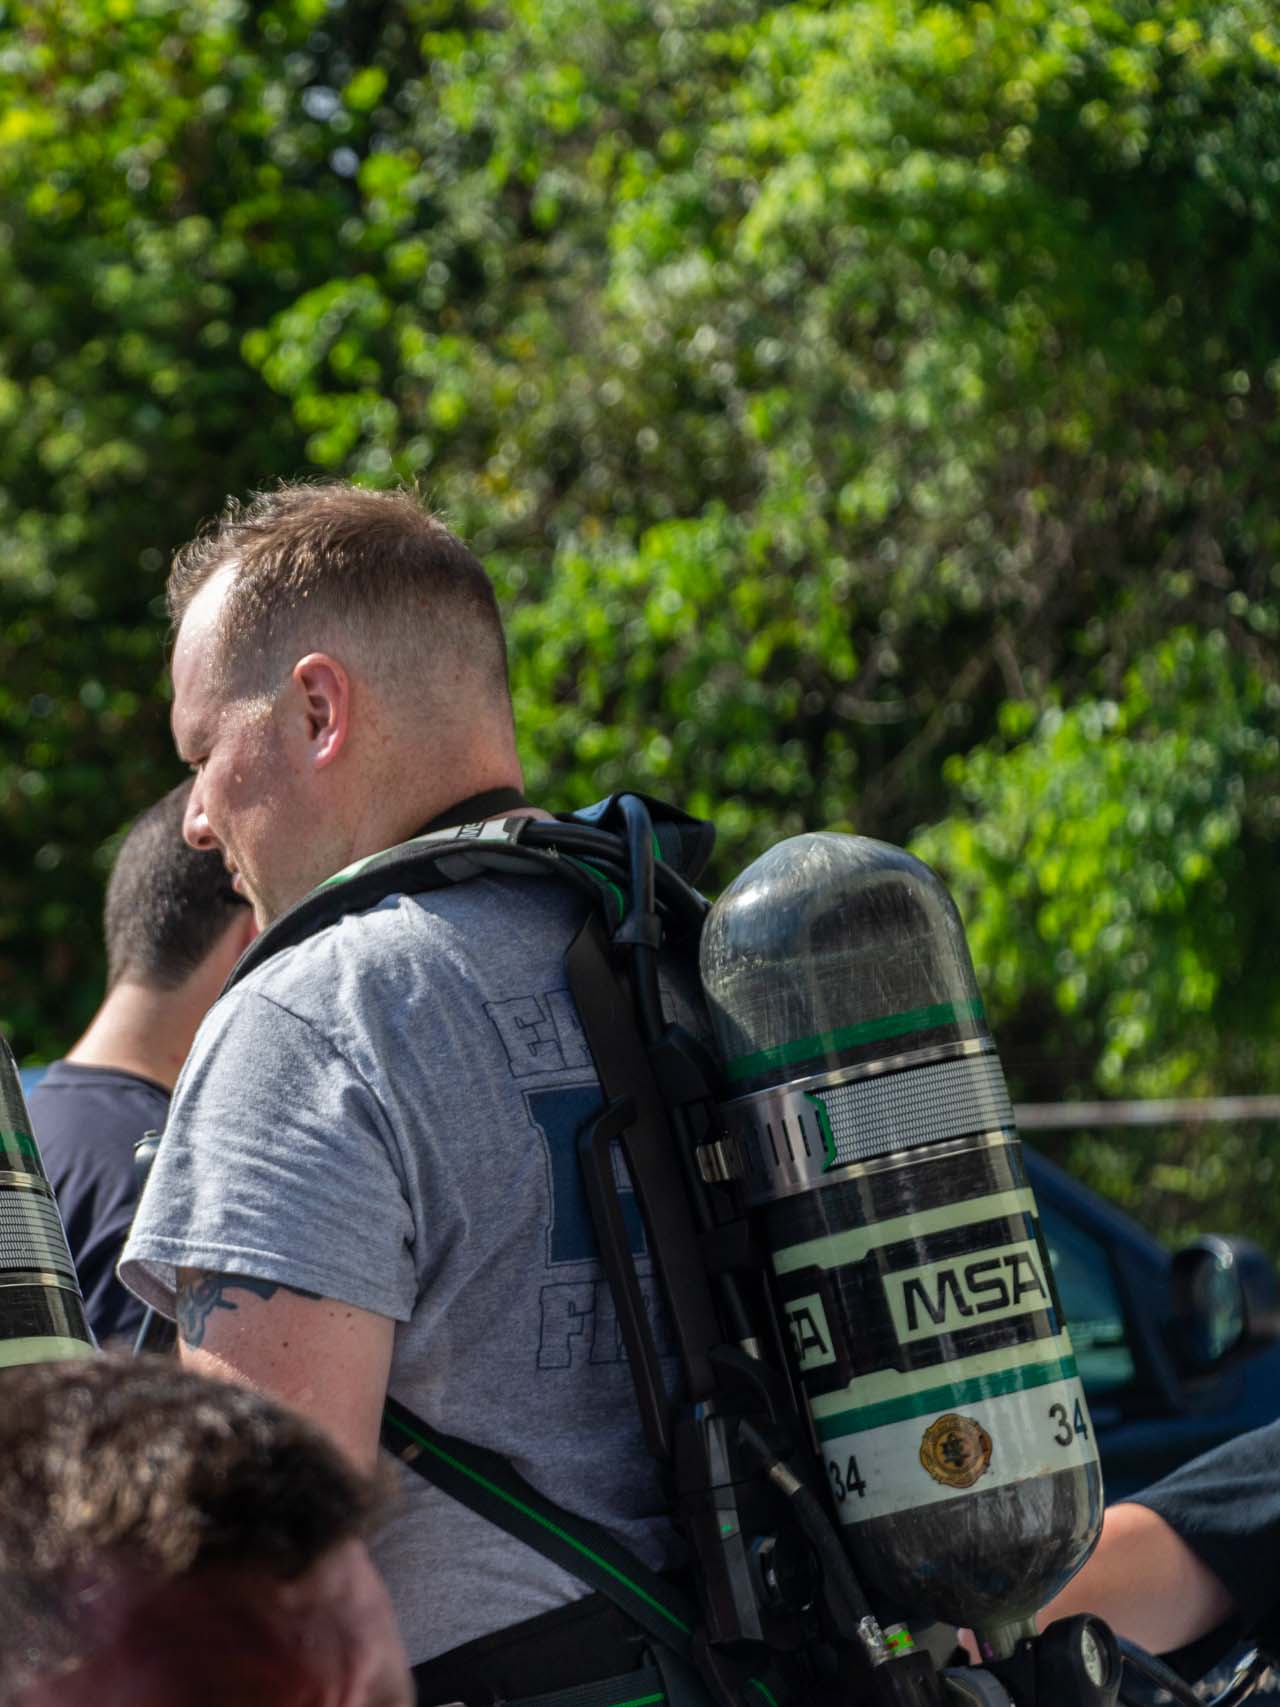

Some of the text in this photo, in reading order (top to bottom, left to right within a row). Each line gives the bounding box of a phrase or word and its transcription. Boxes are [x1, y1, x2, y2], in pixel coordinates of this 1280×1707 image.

[902, 1251, 1048, 1332] MSA
[1048, 1397, 1088, 1447] 34
[829, 1454, 867, 1502] 34
